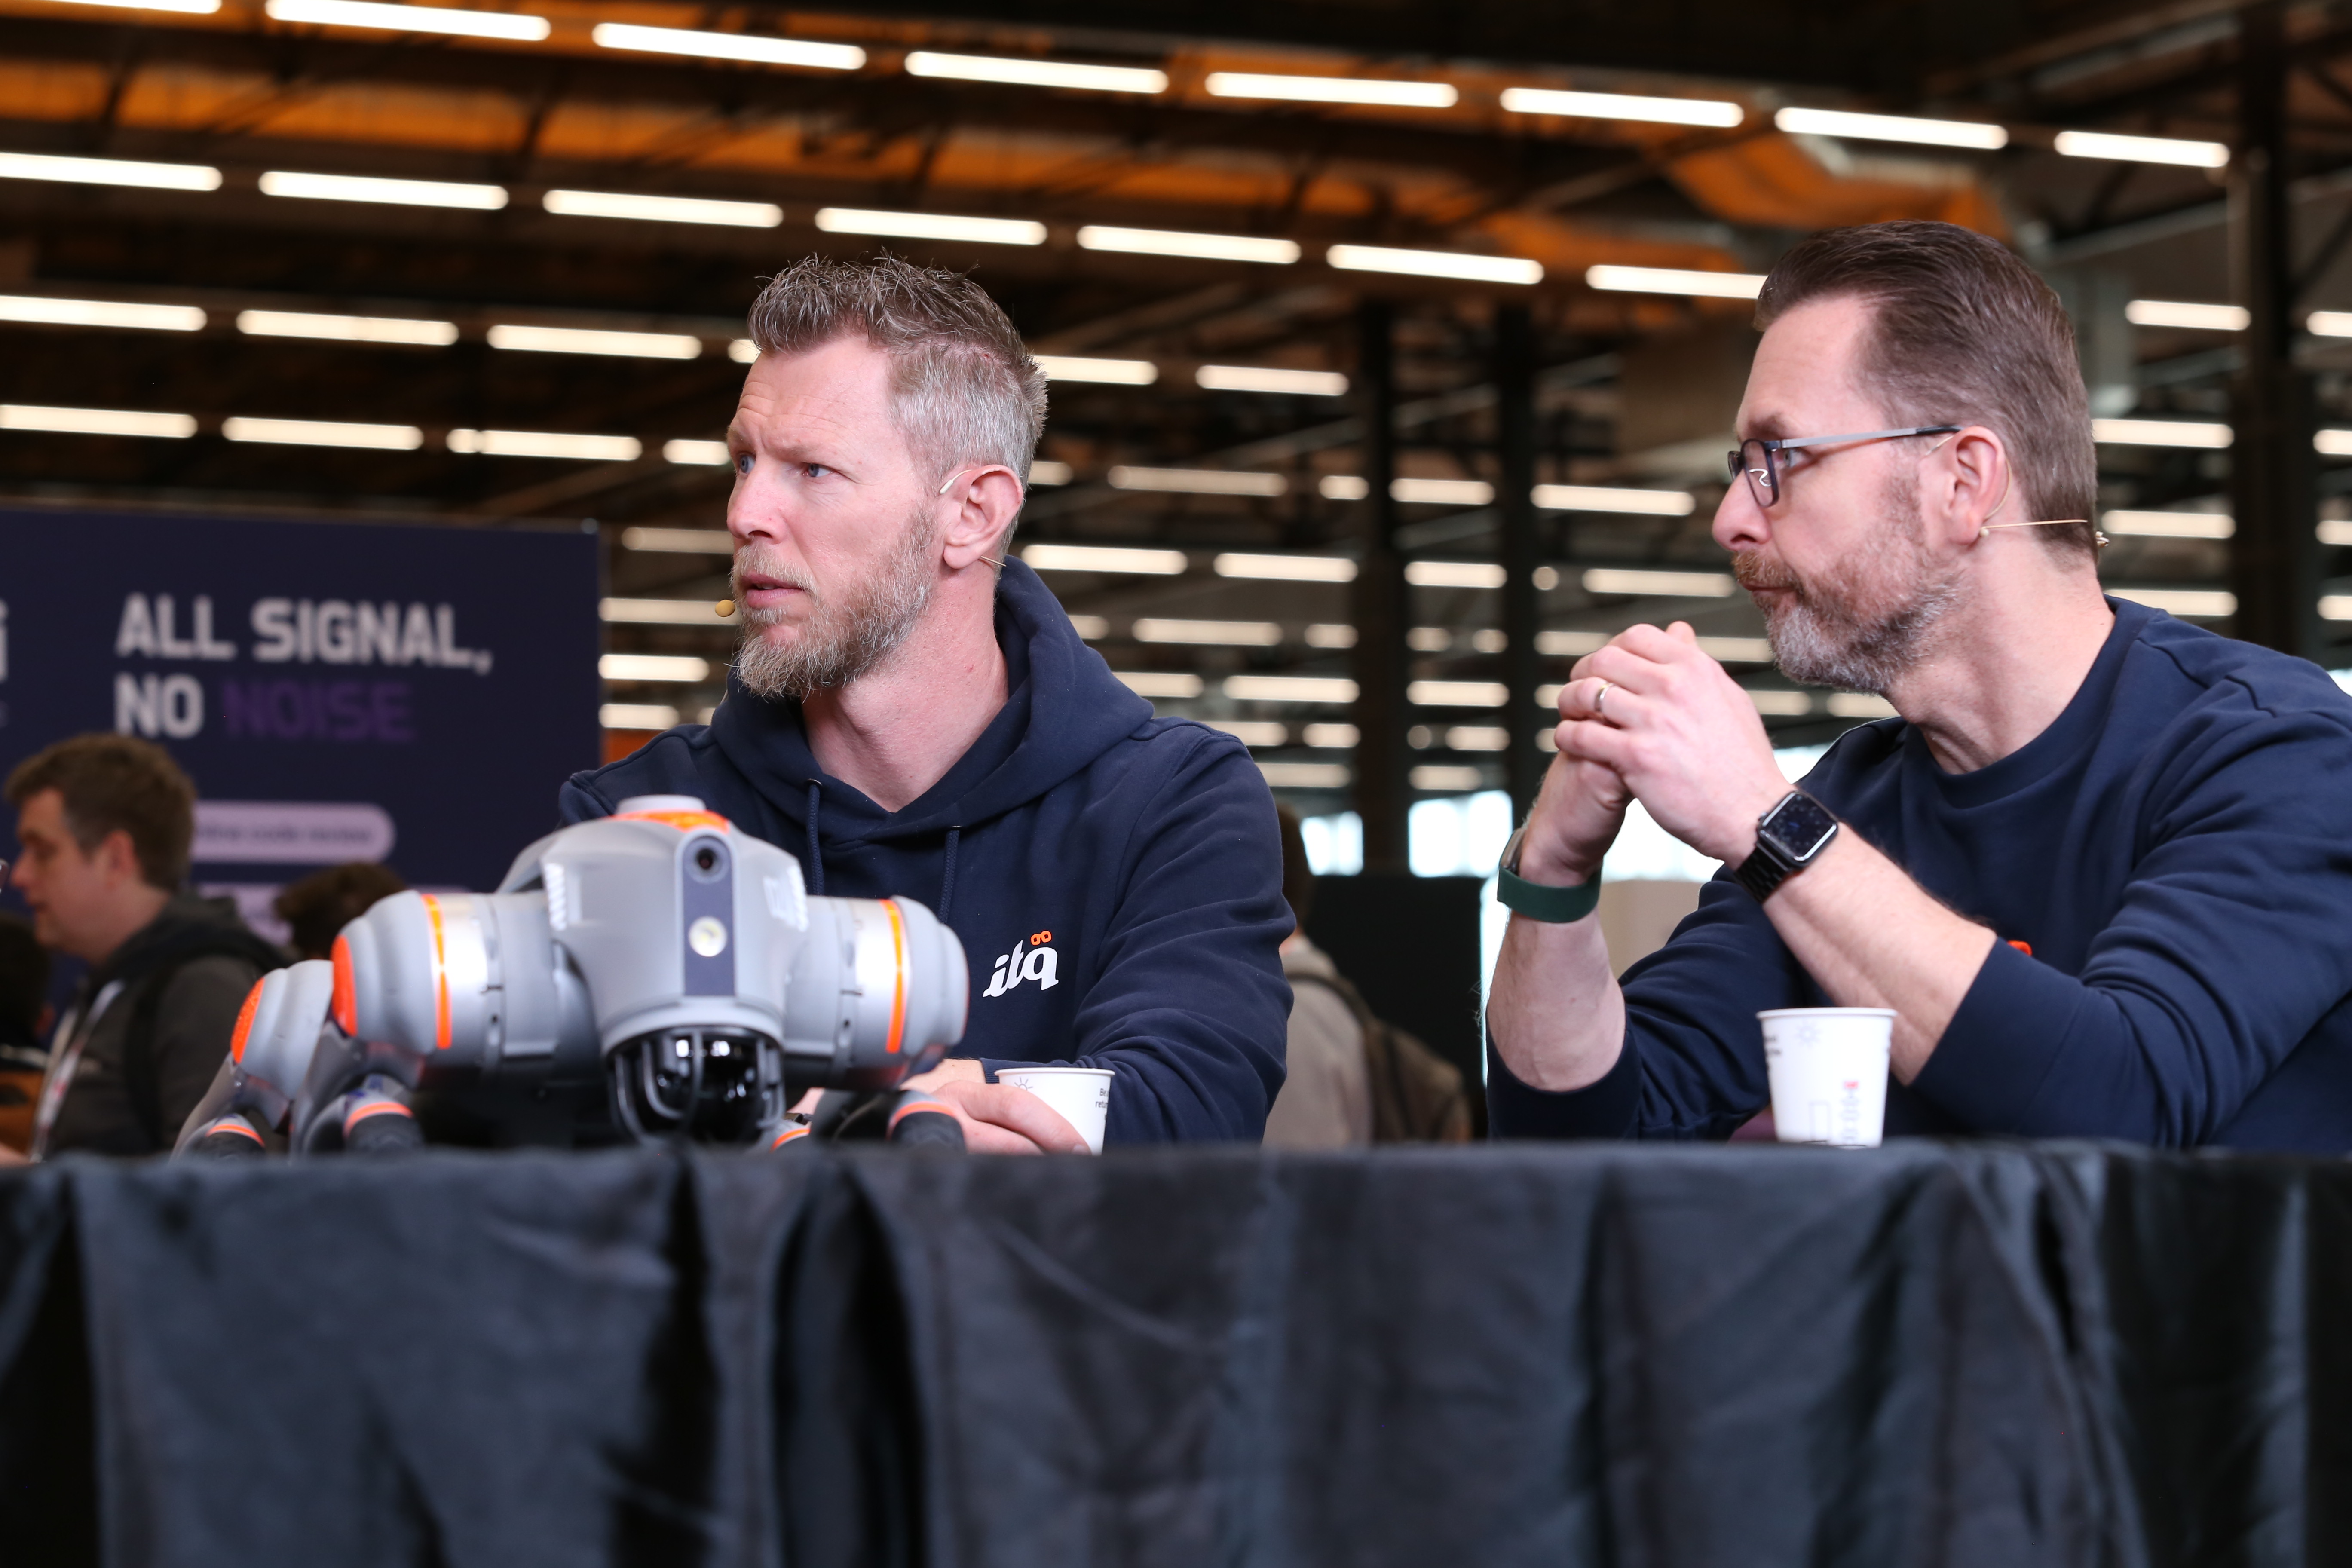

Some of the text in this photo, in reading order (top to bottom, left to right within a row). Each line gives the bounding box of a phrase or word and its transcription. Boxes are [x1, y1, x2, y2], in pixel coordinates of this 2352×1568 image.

[116, 593, 493, 675] ALL SIGNAL,
[114, 674, 416, 742] NO NOISE
